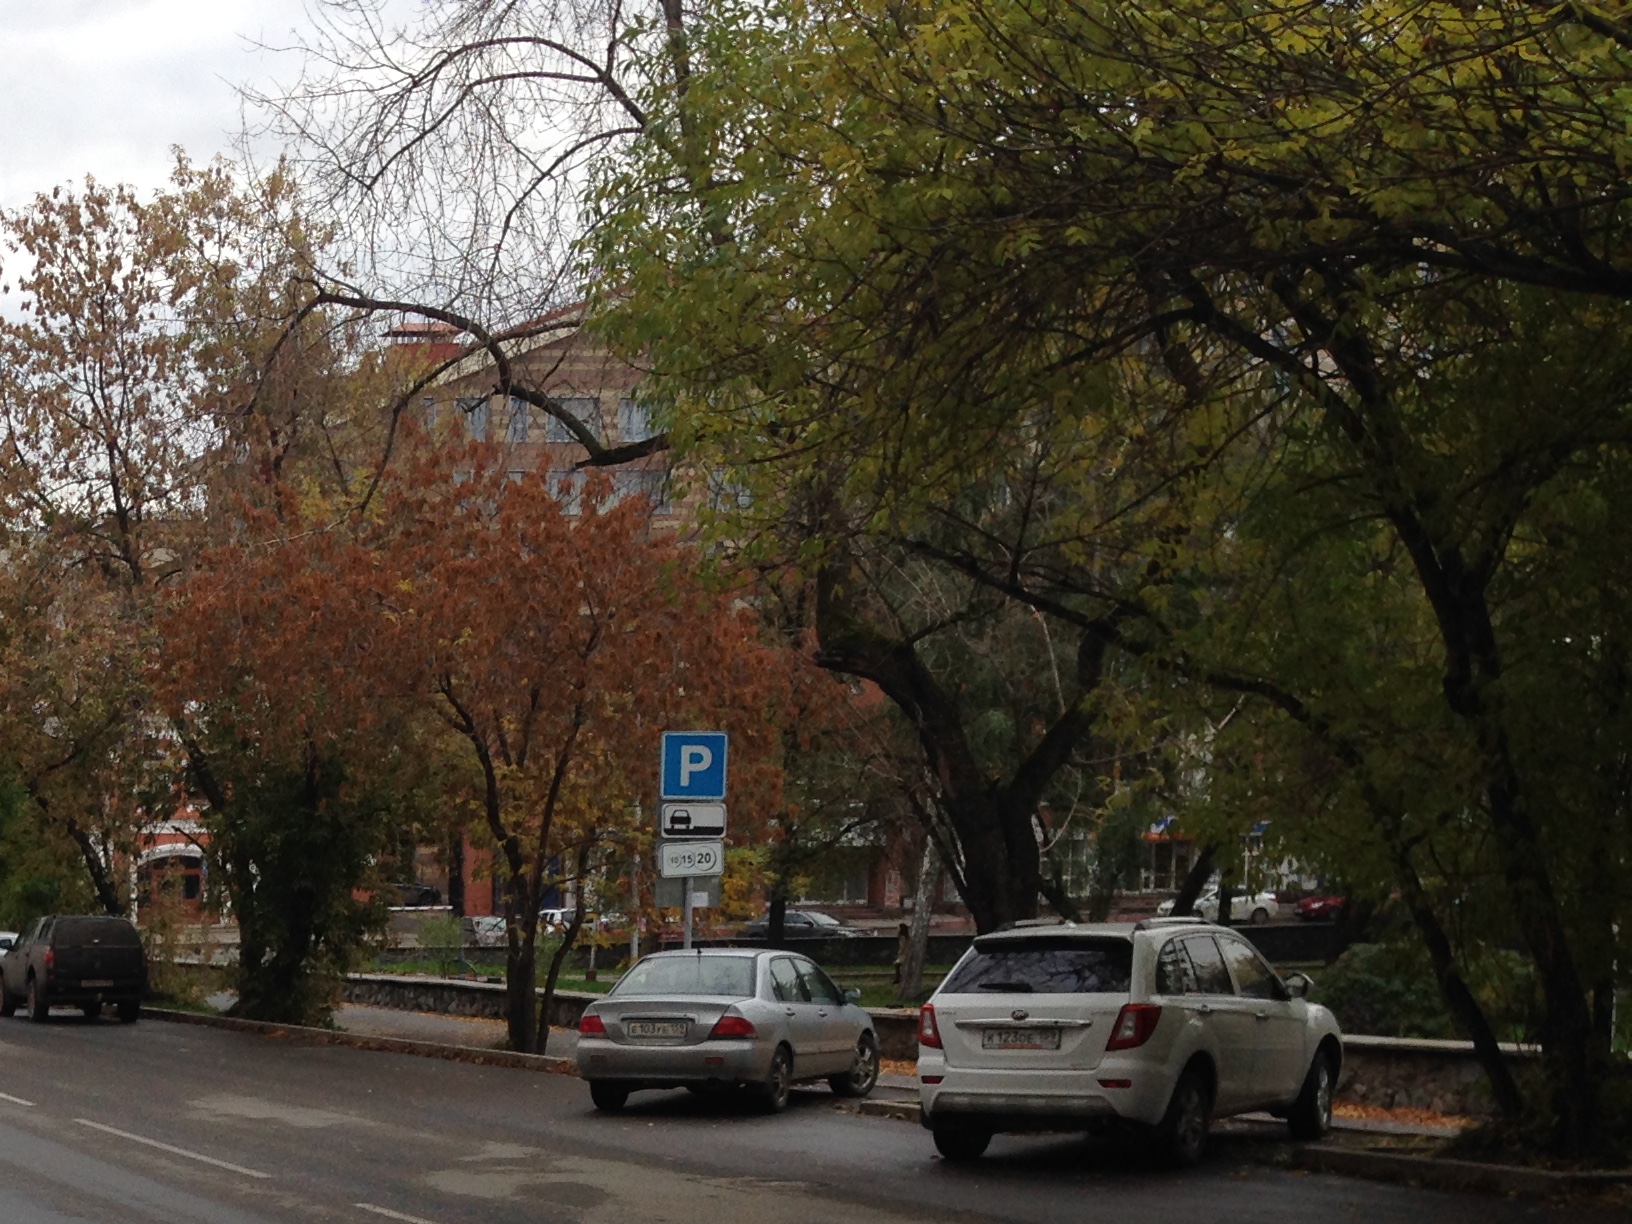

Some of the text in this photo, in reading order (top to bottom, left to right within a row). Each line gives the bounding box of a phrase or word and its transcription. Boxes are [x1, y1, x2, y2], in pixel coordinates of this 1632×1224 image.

[680, 745, 712, 786] P
[681, 855, 693, 864] 15
[697, 852, 711, 864] 20
